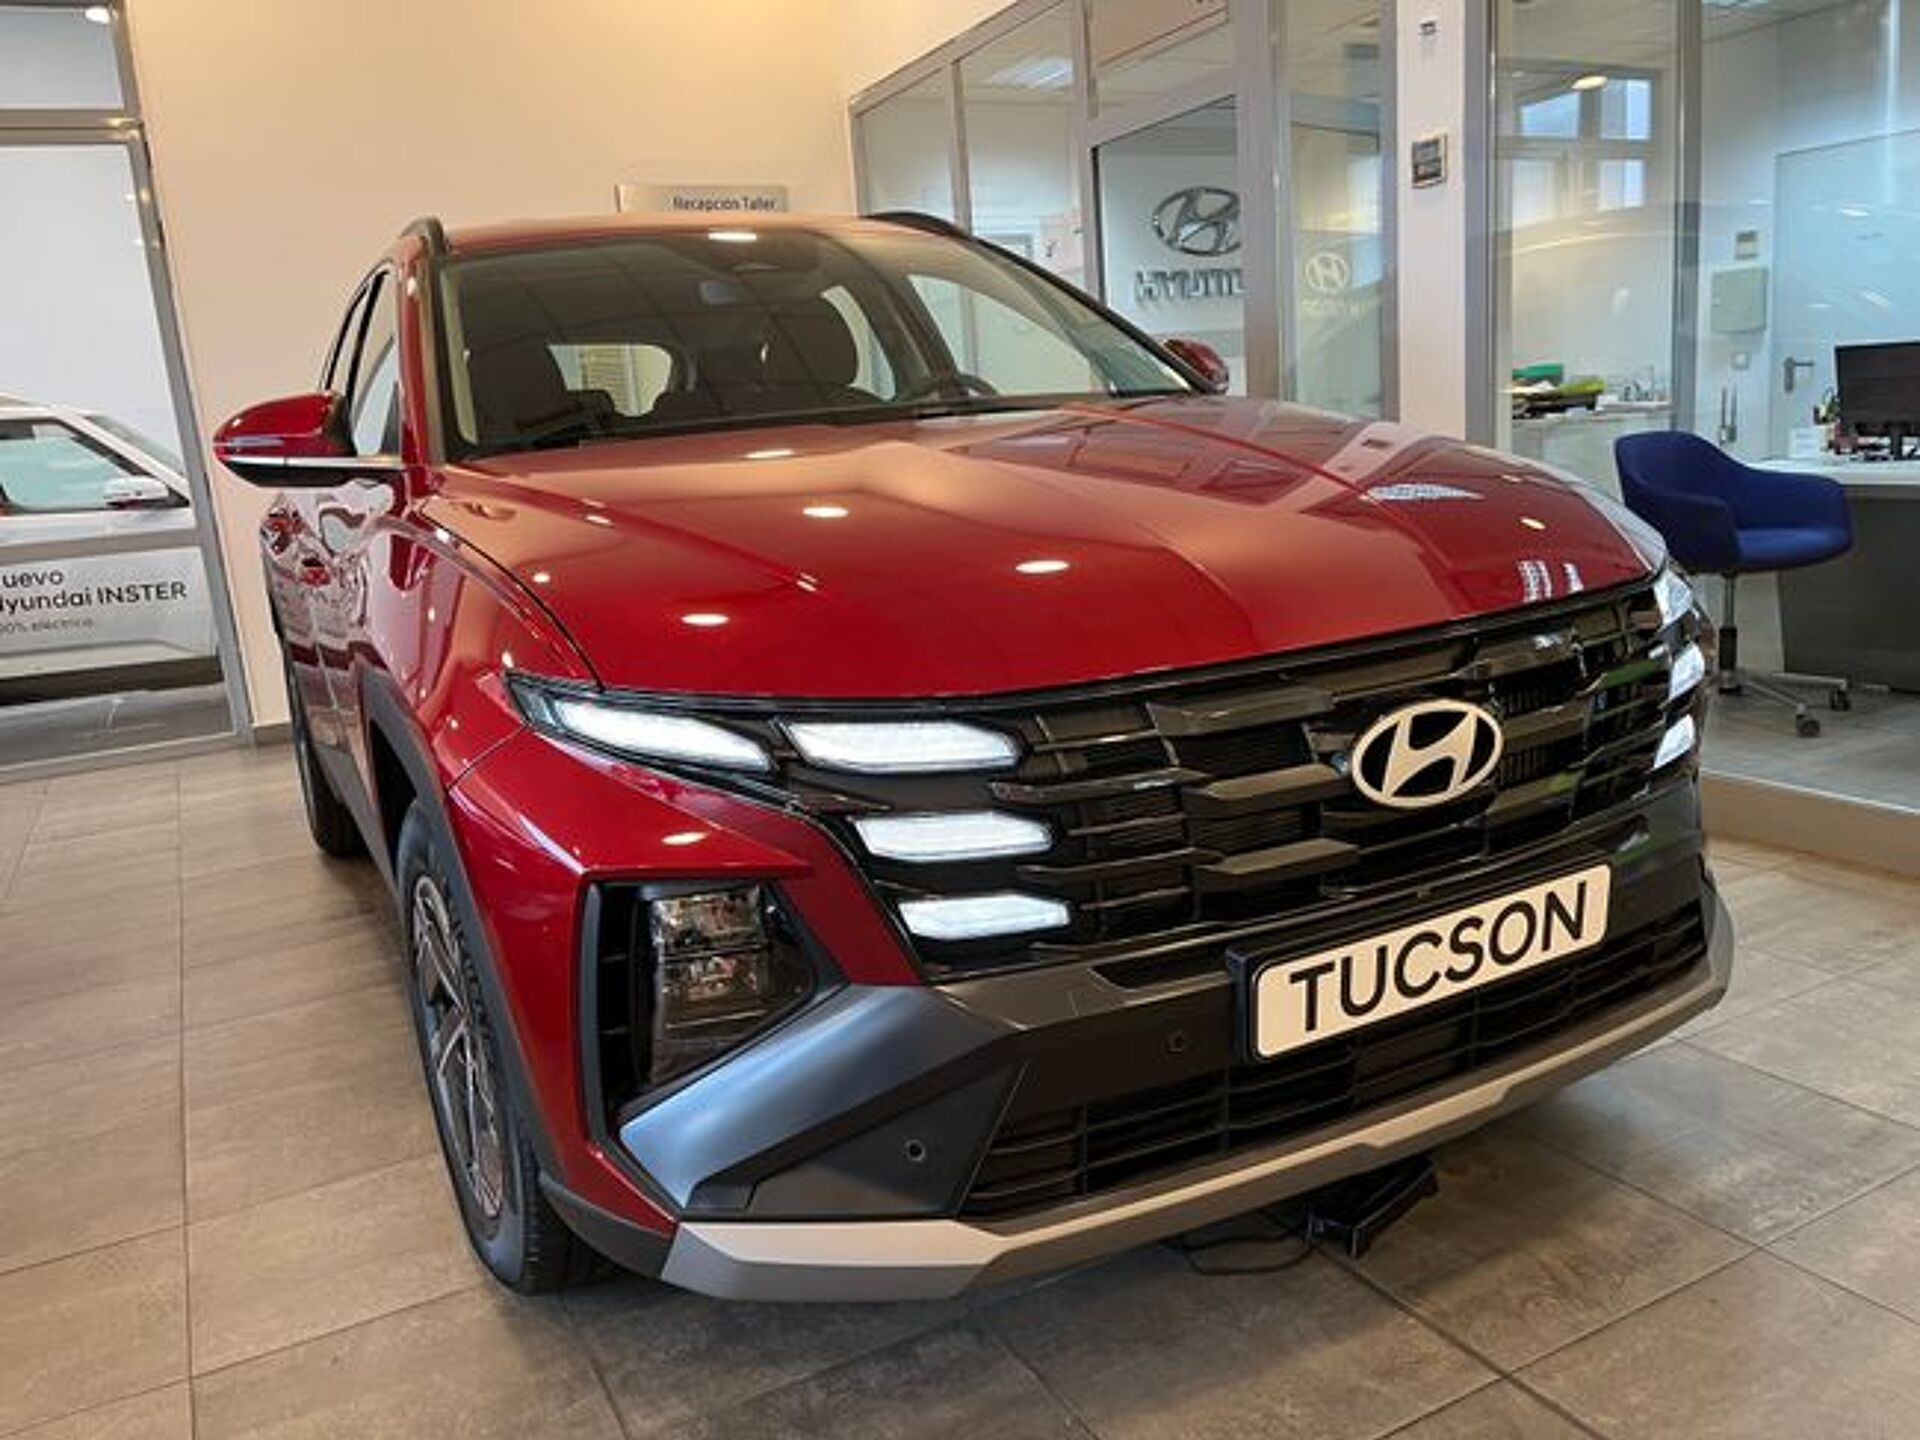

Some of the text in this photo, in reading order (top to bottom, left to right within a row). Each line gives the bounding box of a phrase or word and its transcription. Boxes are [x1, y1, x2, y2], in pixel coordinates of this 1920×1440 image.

[742, 196, 776, 210] Taller
[97, 580, 188, 605] INSTER
[1289, 880, 1588, 1031] TUCSON
